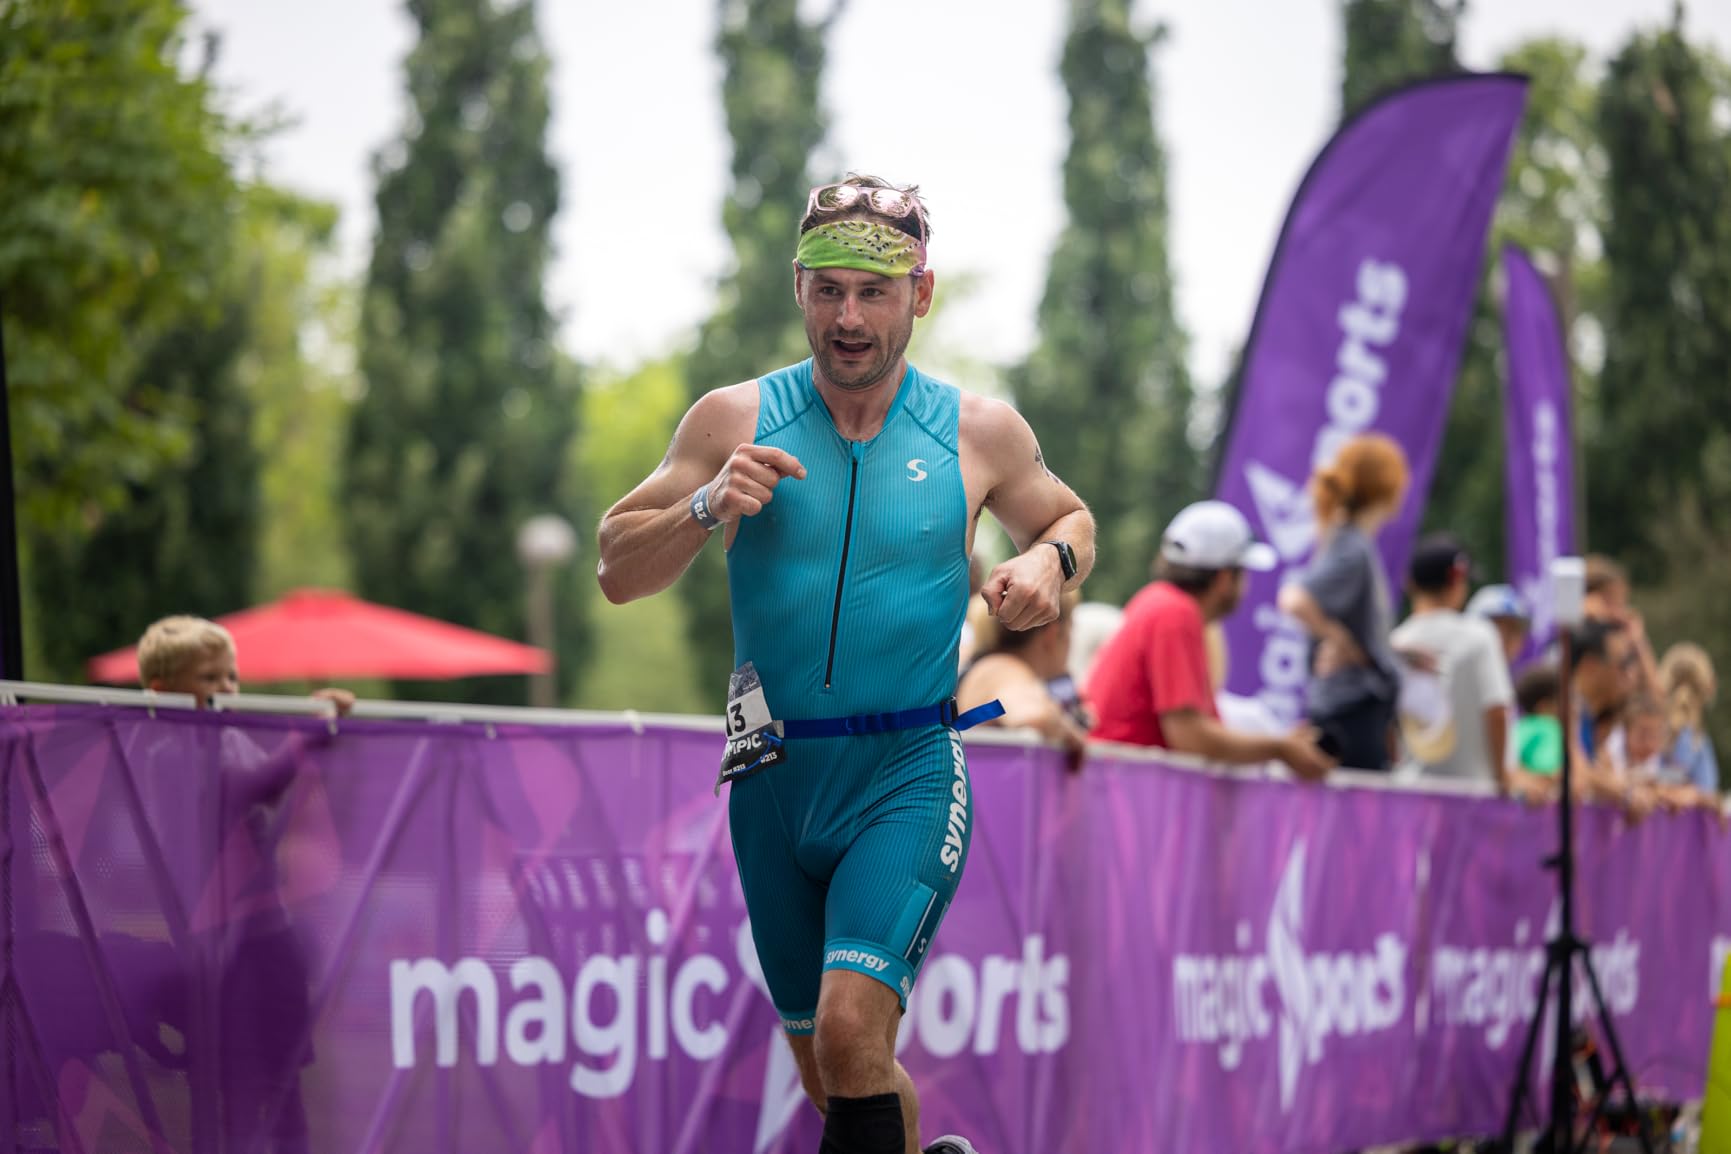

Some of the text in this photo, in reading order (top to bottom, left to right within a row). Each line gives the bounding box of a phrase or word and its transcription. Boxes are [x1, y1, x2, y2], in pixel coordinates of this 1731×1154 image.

[390, 908, 1071, 1099] magic orts
[825, 949, 891, 972] synergy
